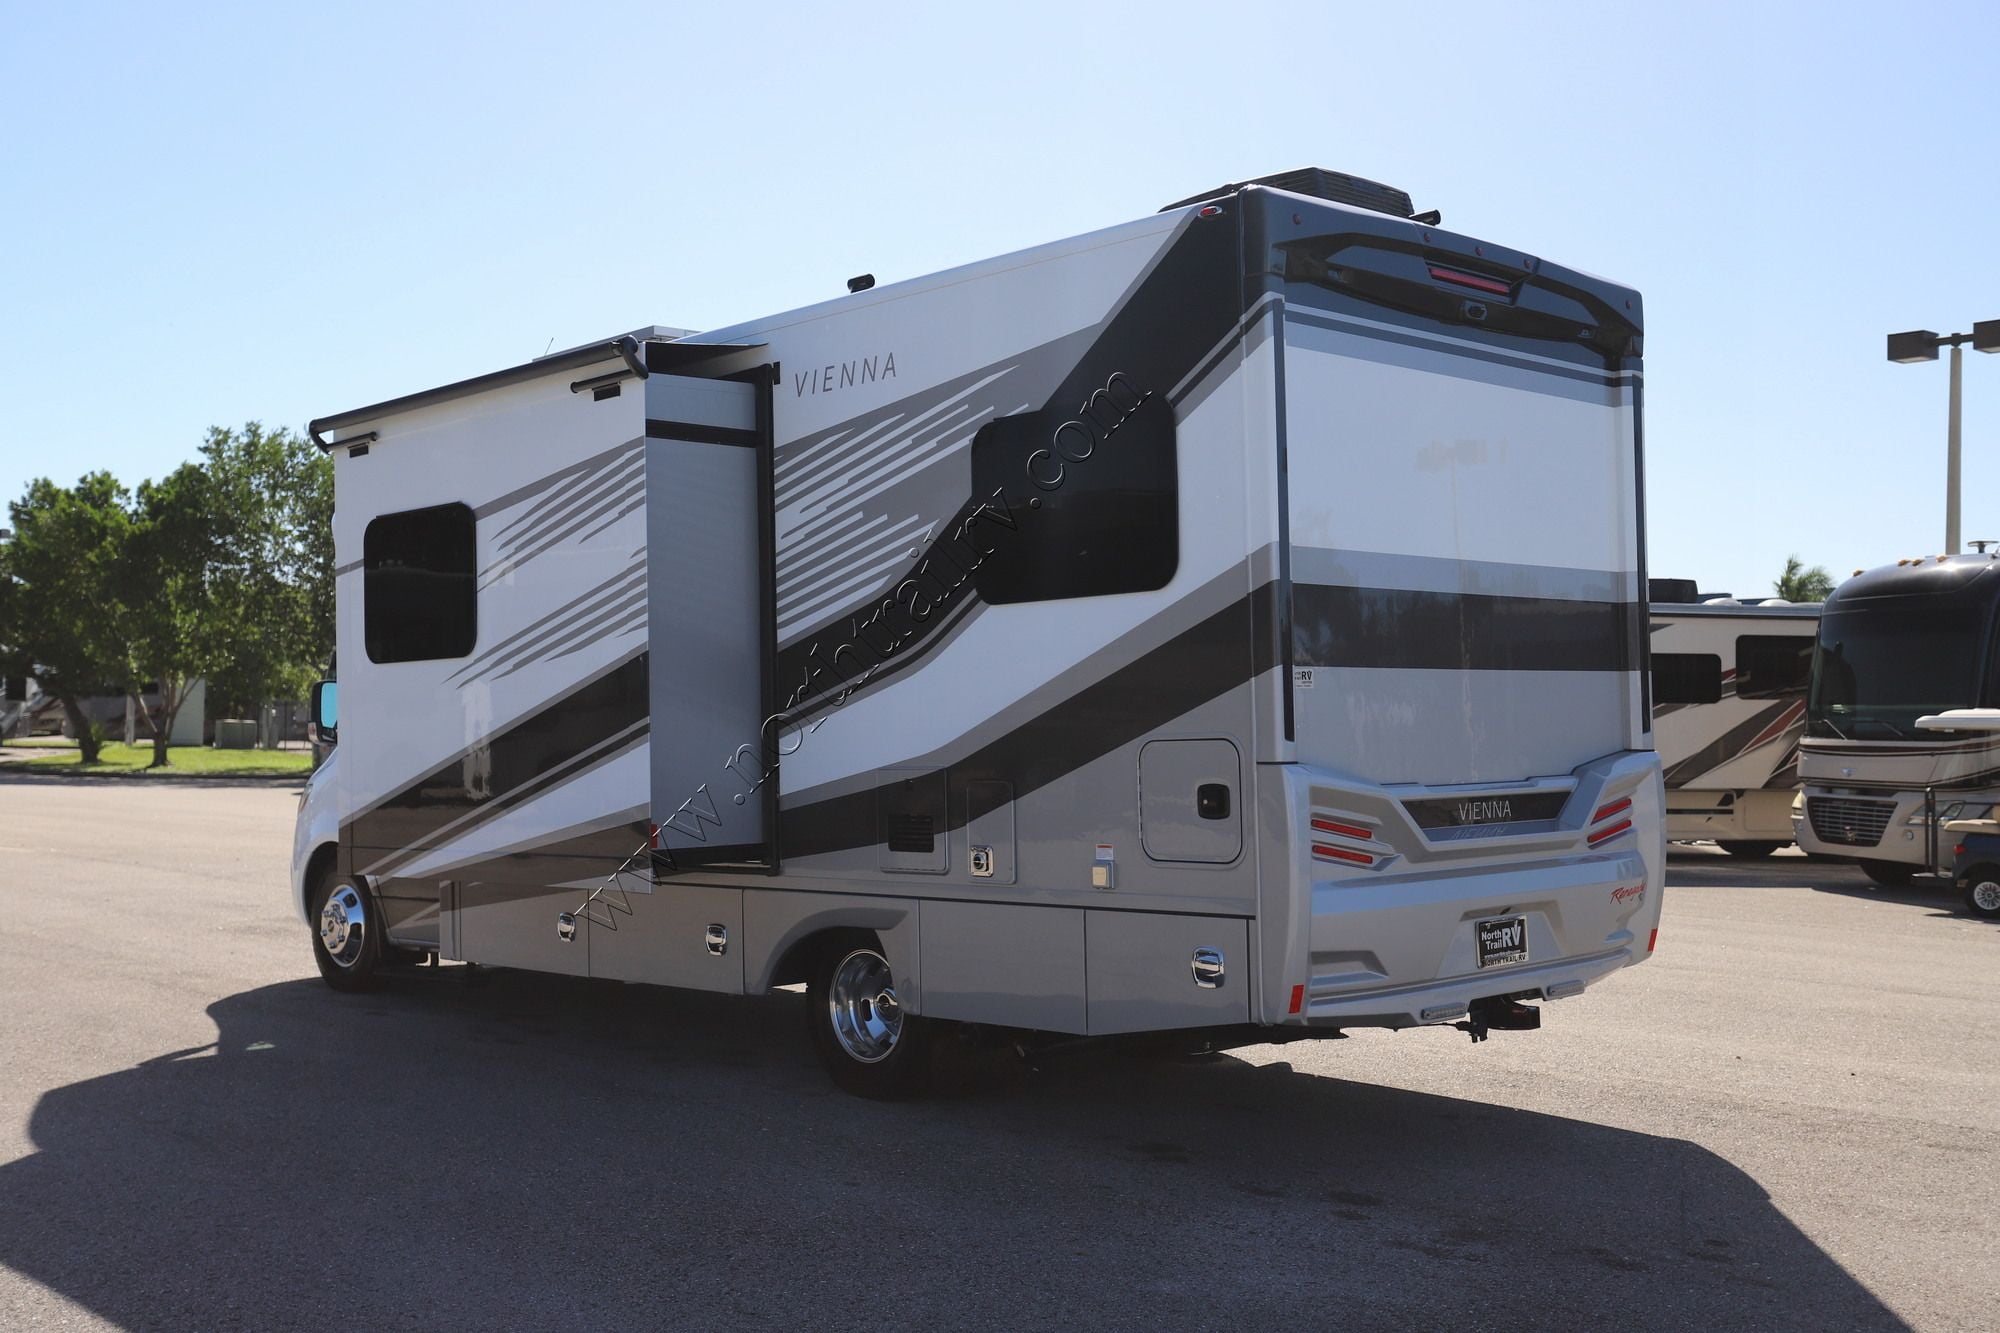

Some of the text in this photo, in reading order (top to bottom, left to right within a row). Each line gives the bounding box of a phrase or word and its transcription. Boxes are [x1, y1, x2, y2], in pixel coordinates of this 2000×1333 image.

[795, 352, 896, 397] VIENNA
[1301, 670, 1313, 681] RV
[1459, 800, 1512, 820] VIENNA
[1481, 929, 1502, 941] North
[1502, 920, 1521, 948] RV
[1485, 939, 1503, 950] Trail
[1518, 953, 1527, 961] RV
